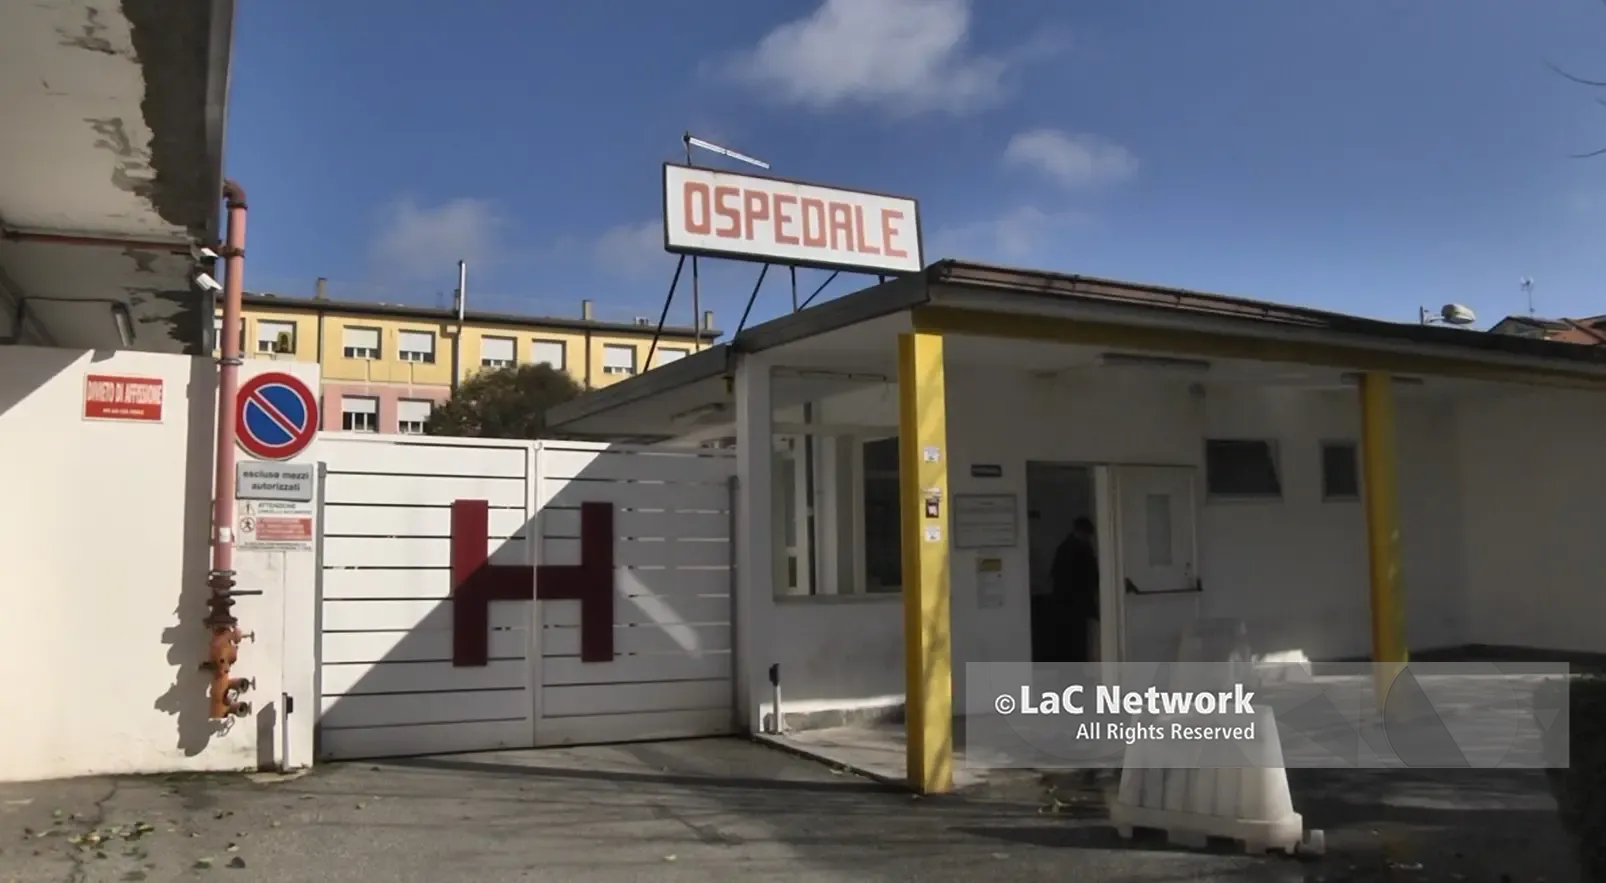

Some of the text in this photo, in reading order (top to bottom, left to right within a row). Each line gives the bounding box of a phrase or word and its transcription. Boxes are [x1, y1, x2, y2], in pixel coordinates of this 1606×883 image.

[684, 181, 907, 258] OSPEDALE
[251, 482, 301, 491] autorizzati
[282, 472, 309, 480] mezzi
[452, 499, 614, 668] H
